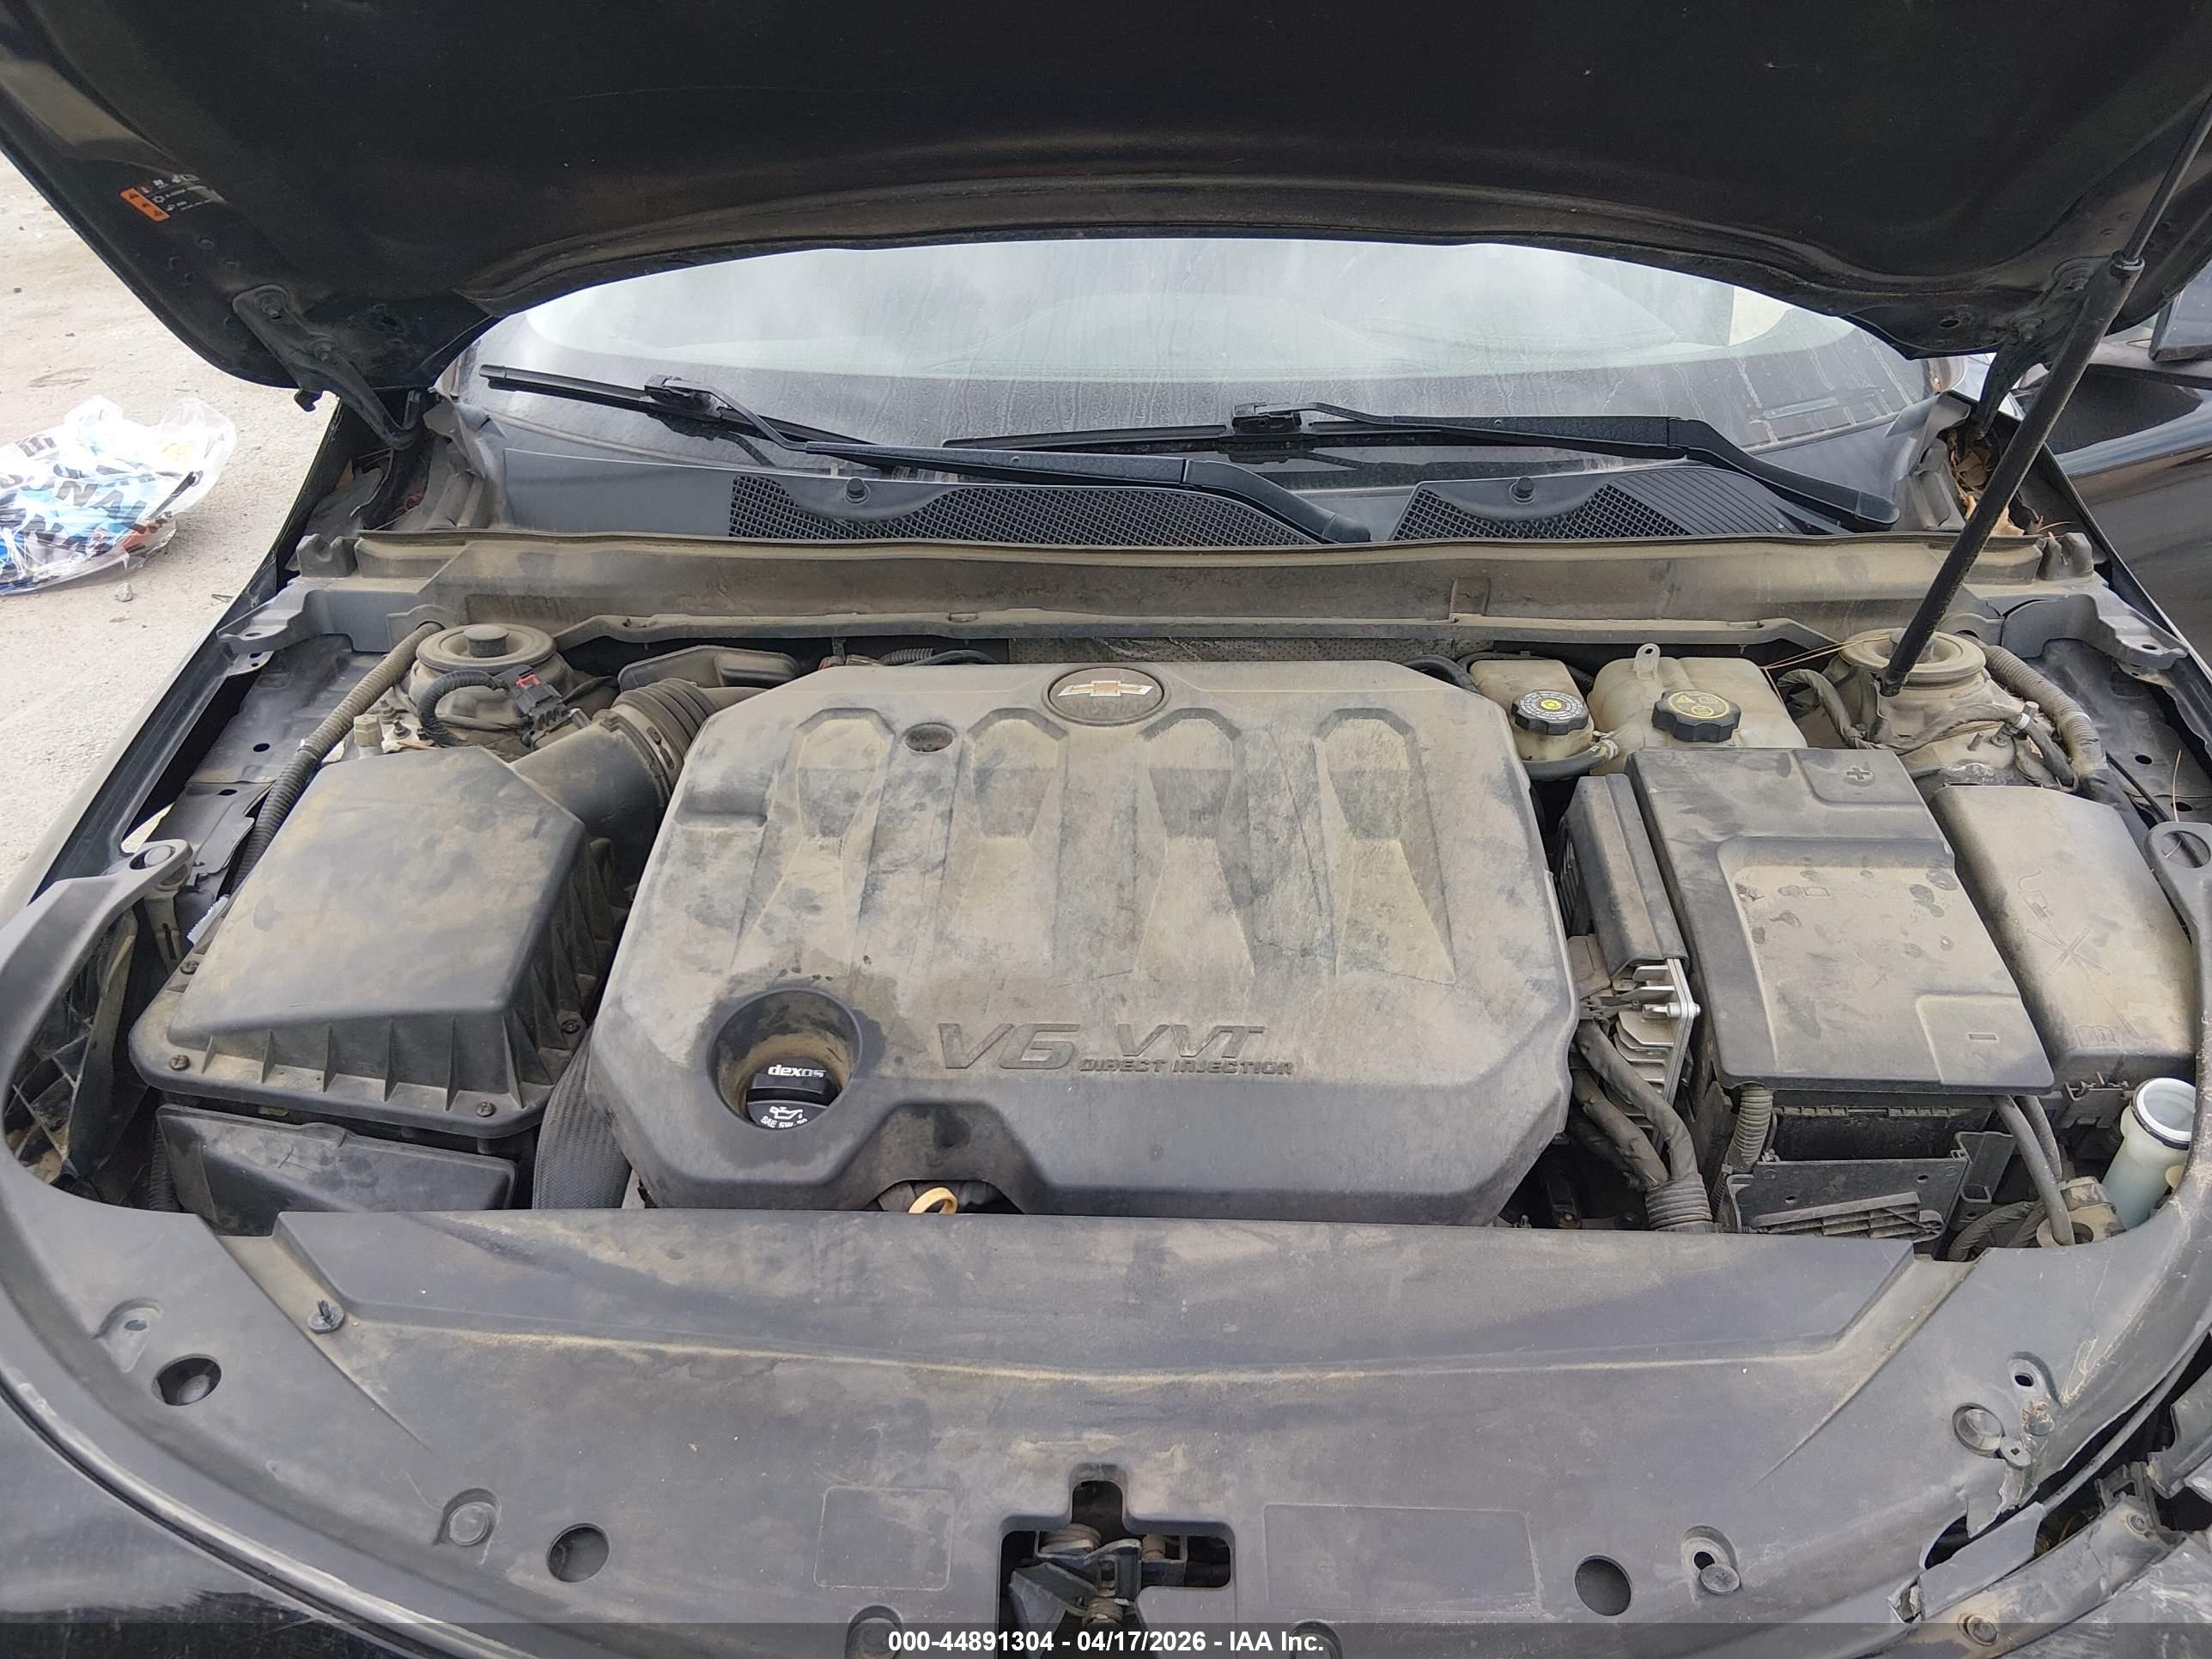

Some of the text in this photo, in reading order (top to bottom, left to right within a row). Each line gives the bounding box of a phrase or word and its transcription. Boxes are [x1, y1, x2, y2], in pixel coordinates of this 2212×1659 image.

[939, 1023, 1265, 1070] V6 VVT
[768, 1064, 826, 1078] dexos
[1079, 1059, 1292, 1075] DIRECT INJECTION
[760, 1115, 778, 1129] SAE
